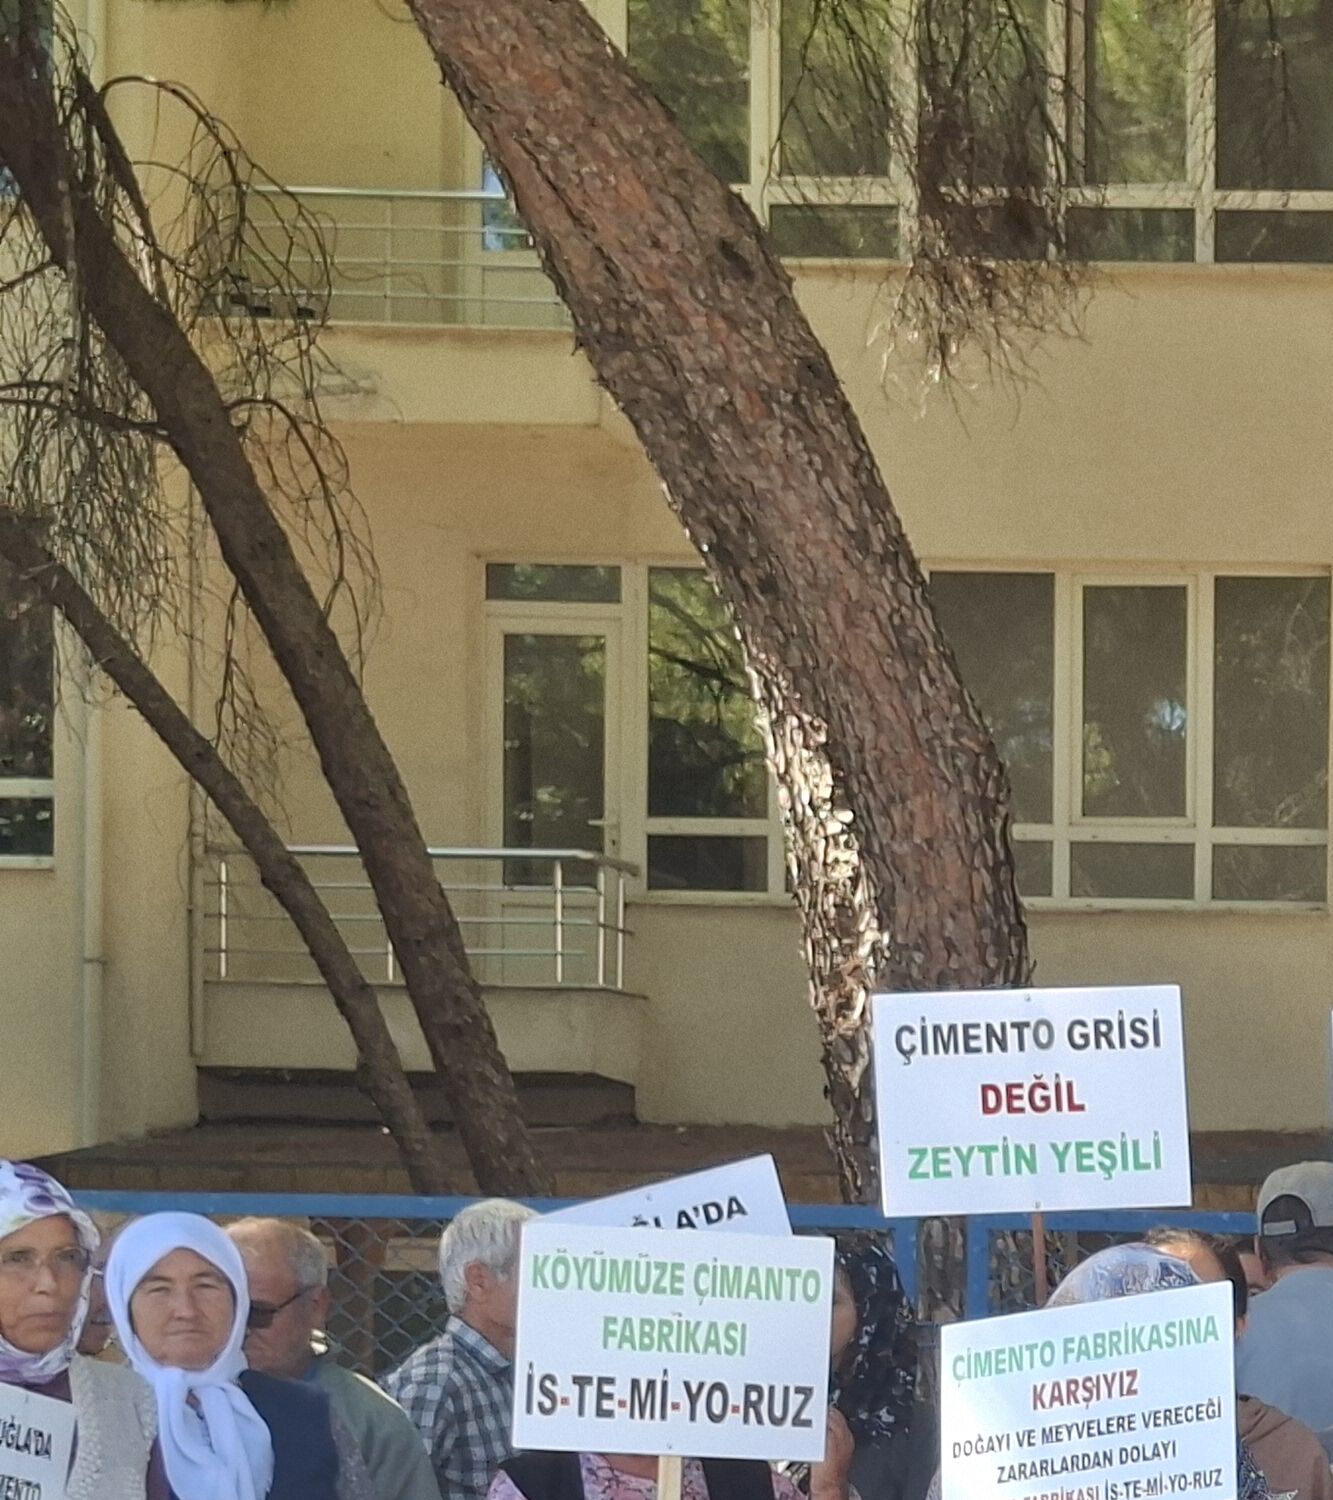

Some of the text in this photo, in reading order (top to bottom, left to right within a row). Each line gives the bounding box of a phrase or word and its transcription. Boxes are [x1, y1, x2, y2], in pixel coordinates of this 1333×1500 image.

[895, 1009, 1161, 1065] ÇİMENTO GRİSİ
[981, 1073, 1085, 1115] DEĞİL
[908, 1131, 1162, 1180] ZEYTİN YEŞİLİ
[532, 1248, 821, 1305] KÖYÜMÜZE ÇİMANTO
[602, 1311, 747, 1356] FABRİKASI
[952, 1315, 1219, 1387] ÇİMENTO FABRİKASINA
[525, 1361, 814, 1428] İS-TE-Mİ-YO-RUZ
[1033, 1369, 1138, 1410] KARŞIYIZ
[952, 1396, 1222, 1458] DOĞAYI VE MEYVELERE VERECEĞİ
[997, 1440, 1176, 1483] ZARARLARDAN DOLAYI
